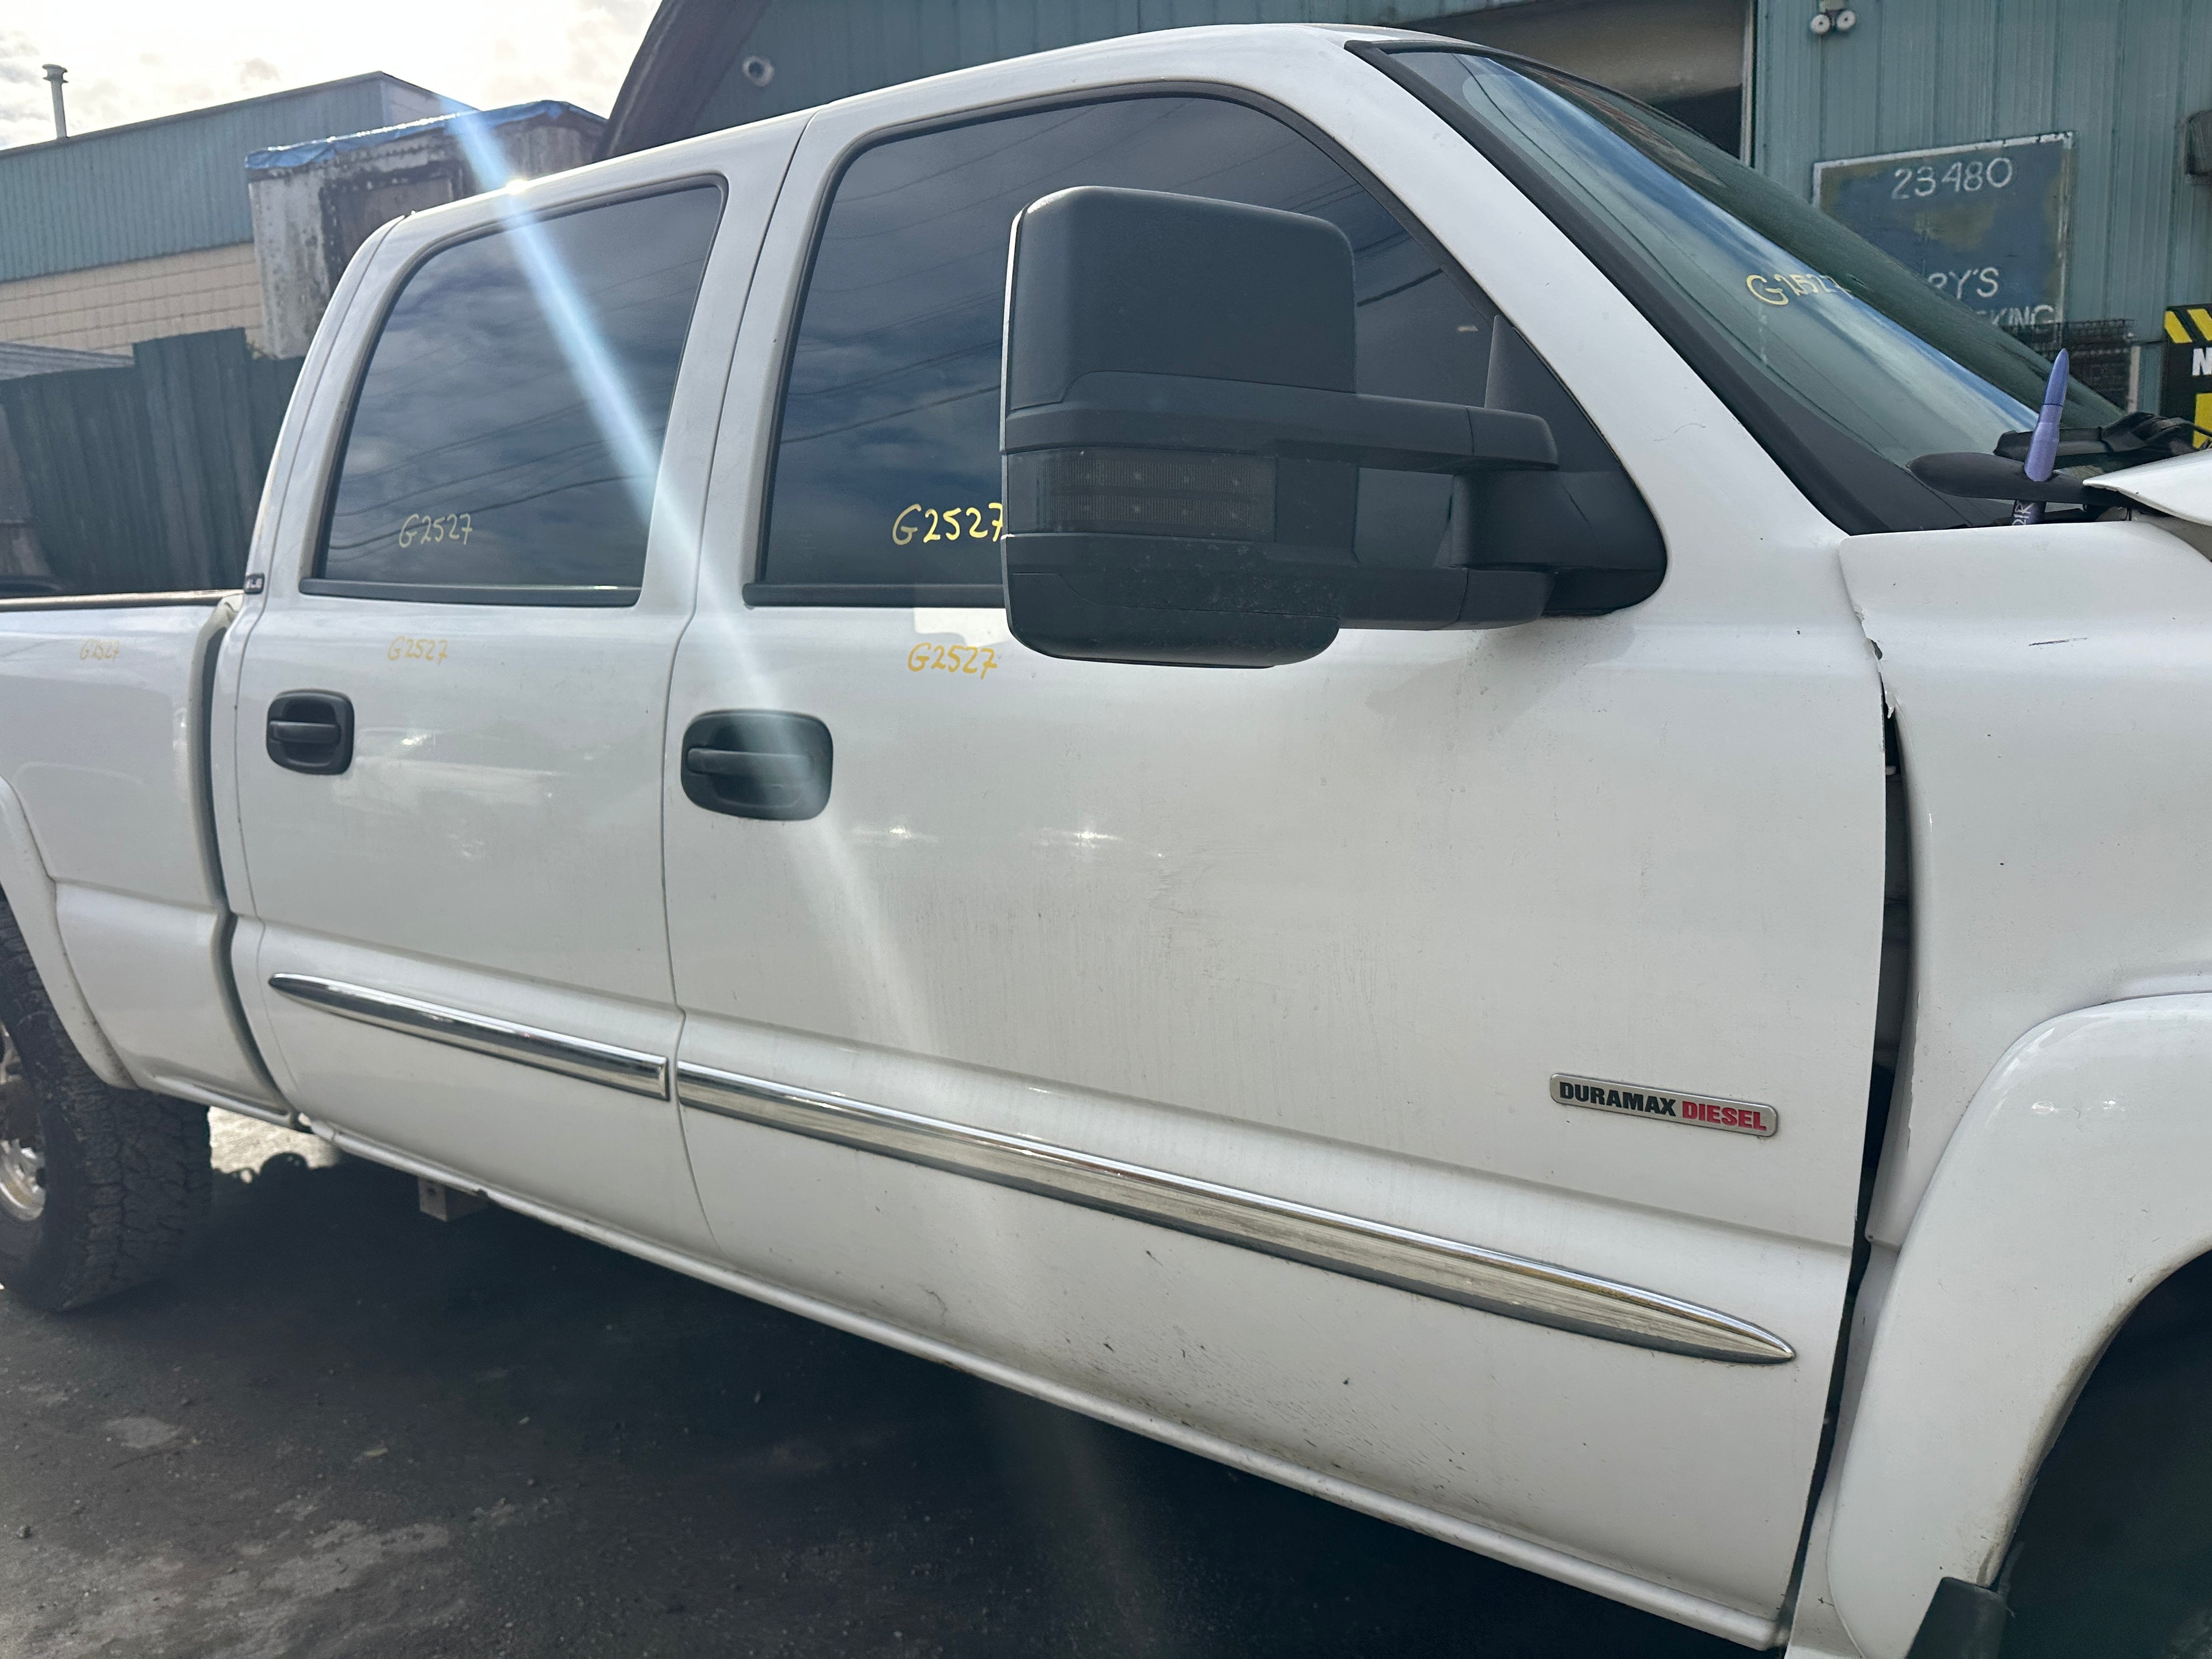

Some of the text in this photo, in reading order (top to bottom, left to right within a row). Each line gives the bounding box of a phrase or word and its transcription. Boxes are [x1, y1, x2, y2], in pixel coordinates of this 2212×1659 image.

[1892, 157, 2013, 199] 23480
[399, 513, 473, 548] G2527
[892, 502, 1003, 546] G2527
[387, 635, 448, 666] G2527
[907, 642, 998, 680] G2527
[1559, 1081, 1767, 1131] DURAMAX DIESEL
